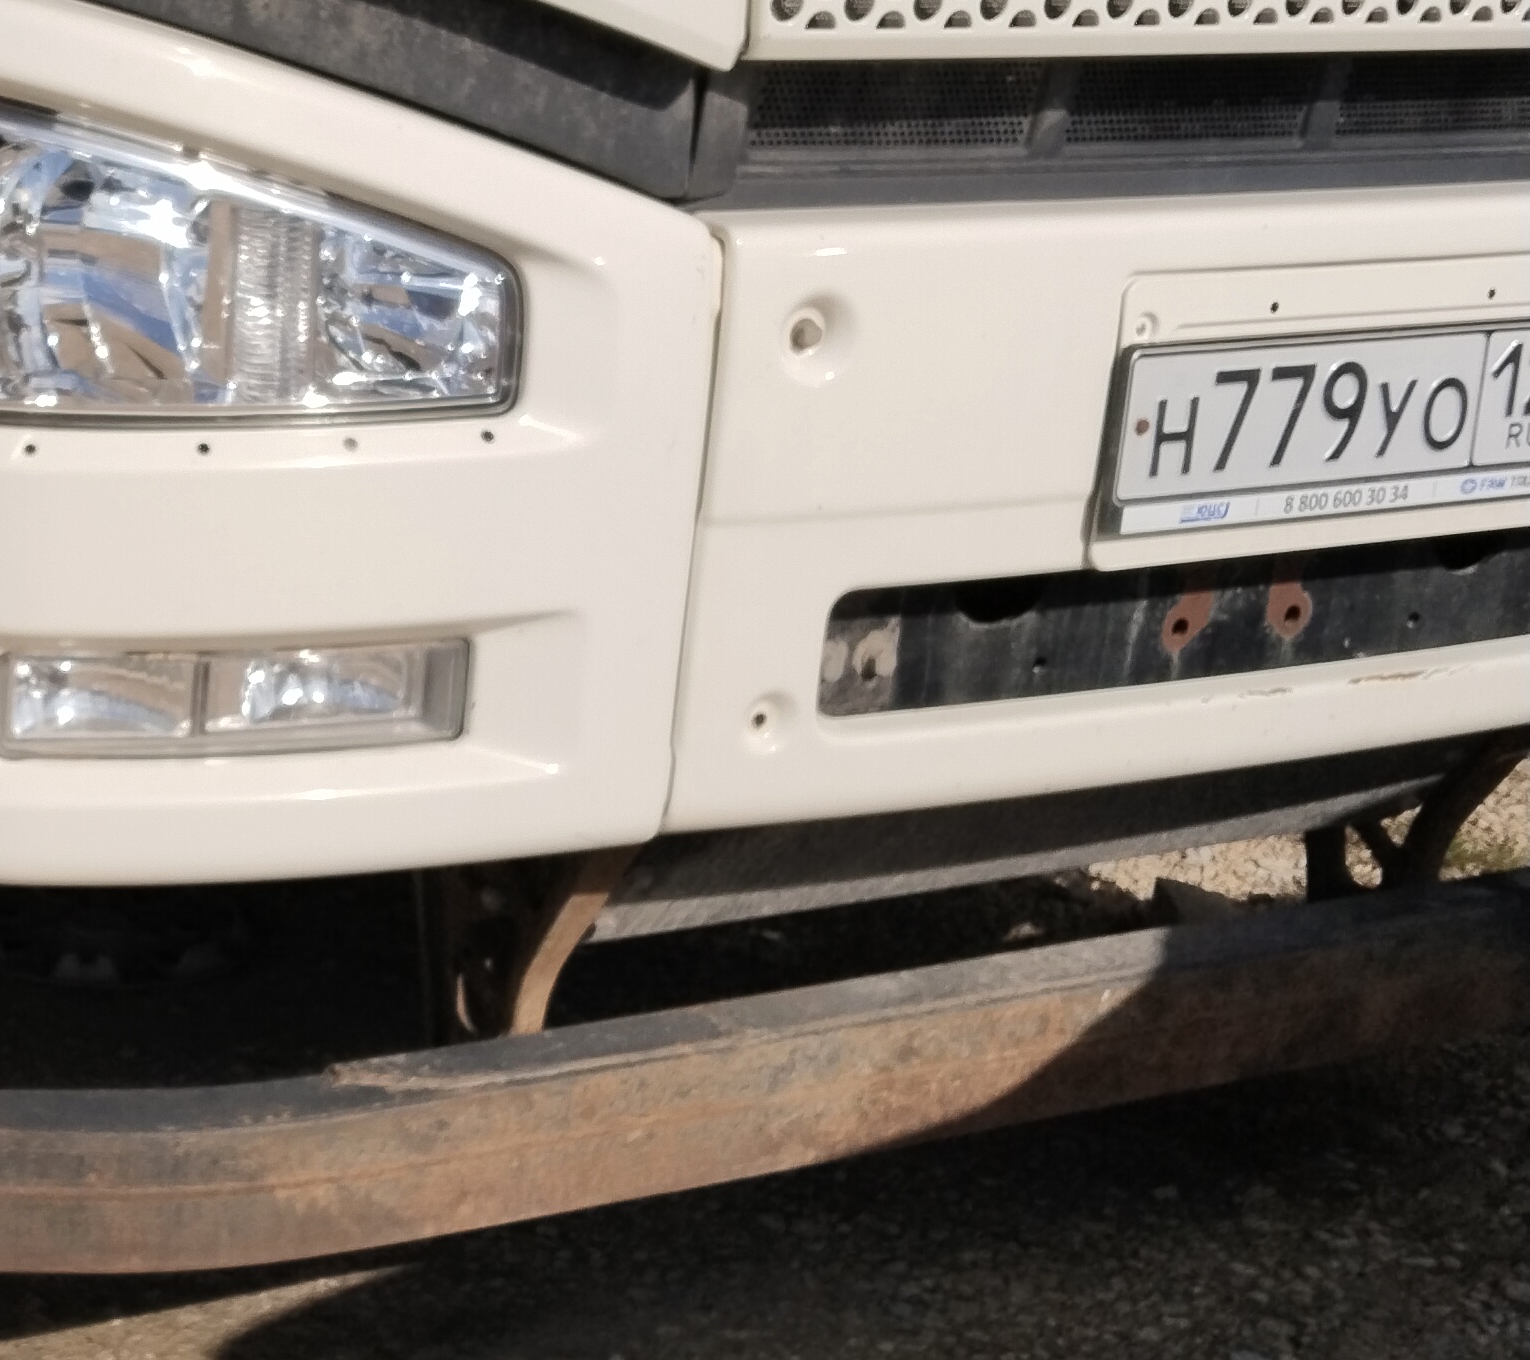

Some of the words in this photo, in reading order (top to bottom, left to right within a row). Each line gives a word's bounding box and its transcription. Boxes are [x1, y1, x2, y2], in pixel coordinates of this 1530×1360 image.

[1492, 340, 1530, 419] 1
[1283, 496, 1294, 515] 8
[1298, 492, 1329, 512] 800
[1333, 489, 1364, 509] 600
[1366, 486, 1387, 506] 30
[1390, 484, 1410, 503] 34
